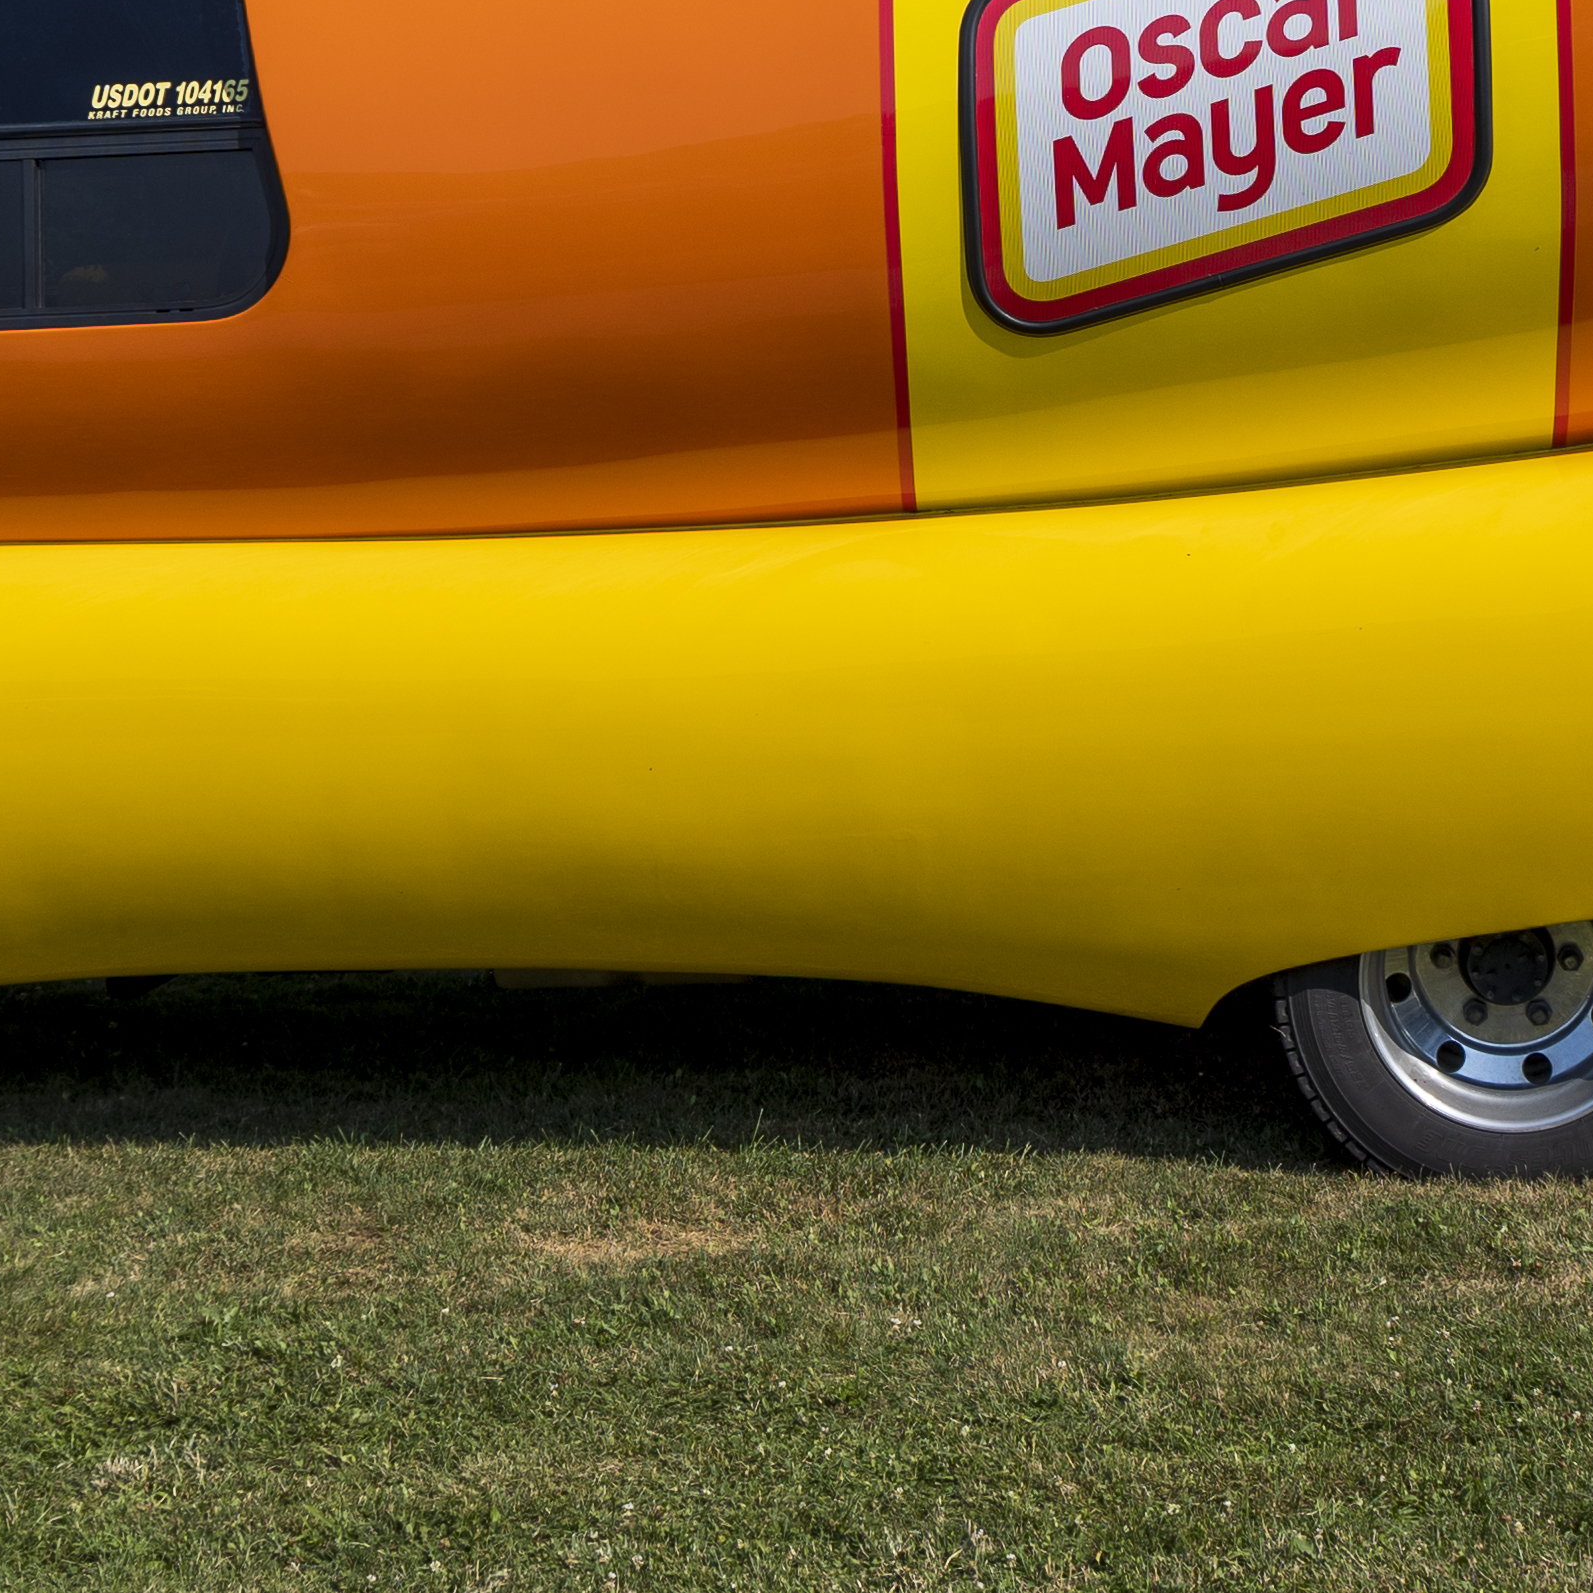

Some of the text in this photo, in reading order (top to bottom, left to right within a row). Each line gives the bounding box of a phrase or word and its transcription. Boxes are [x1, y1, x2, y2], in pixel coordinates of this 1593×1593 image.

[91, 79, 249, 109] USDOT 104165
[88, 109, 128, 120] KRAFT
[132, 107, 172, 118] FOODS
[1052, 46, 1402, 230] Mayer
